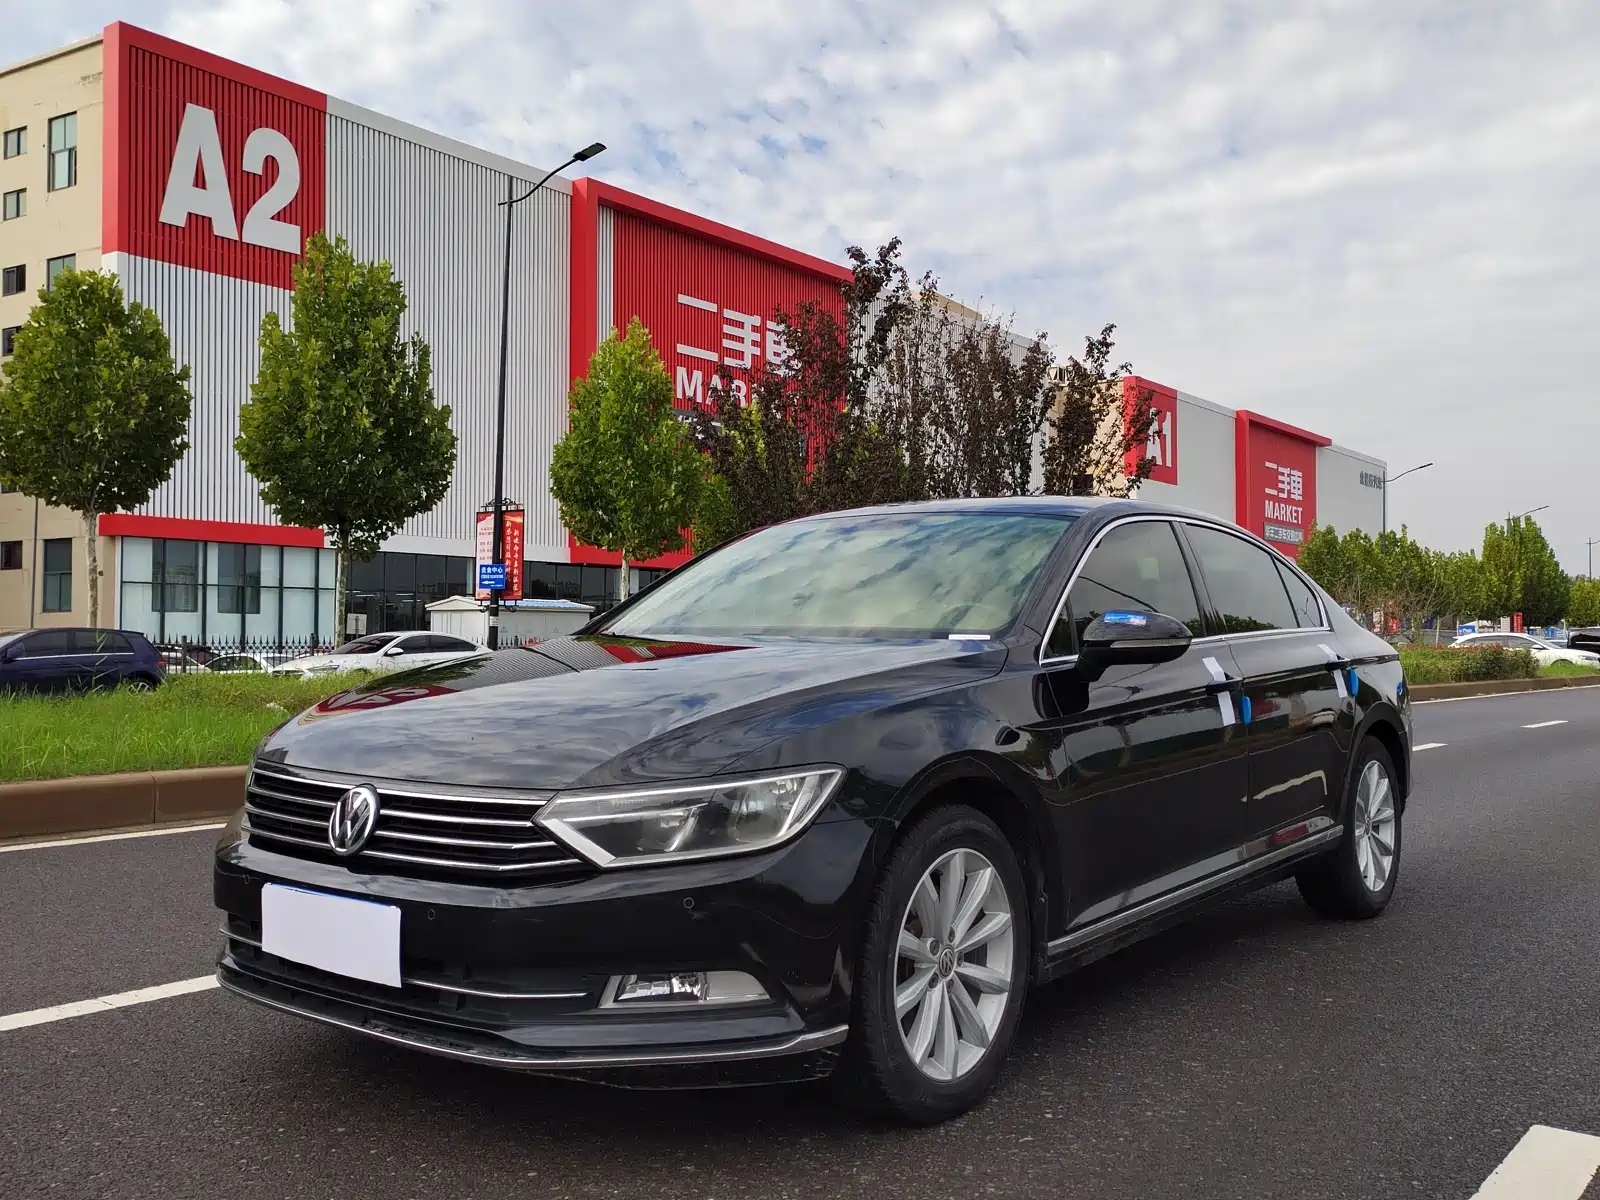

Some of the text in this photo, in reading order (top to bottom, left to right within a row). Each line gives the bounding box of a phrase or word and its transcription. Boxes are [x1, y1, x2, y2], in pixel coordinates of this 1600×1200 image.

[159, 102, 301, 255] A2
[1146, 407, 1172, 467] A1
[1264, 500, 1303, 524] MARKET
